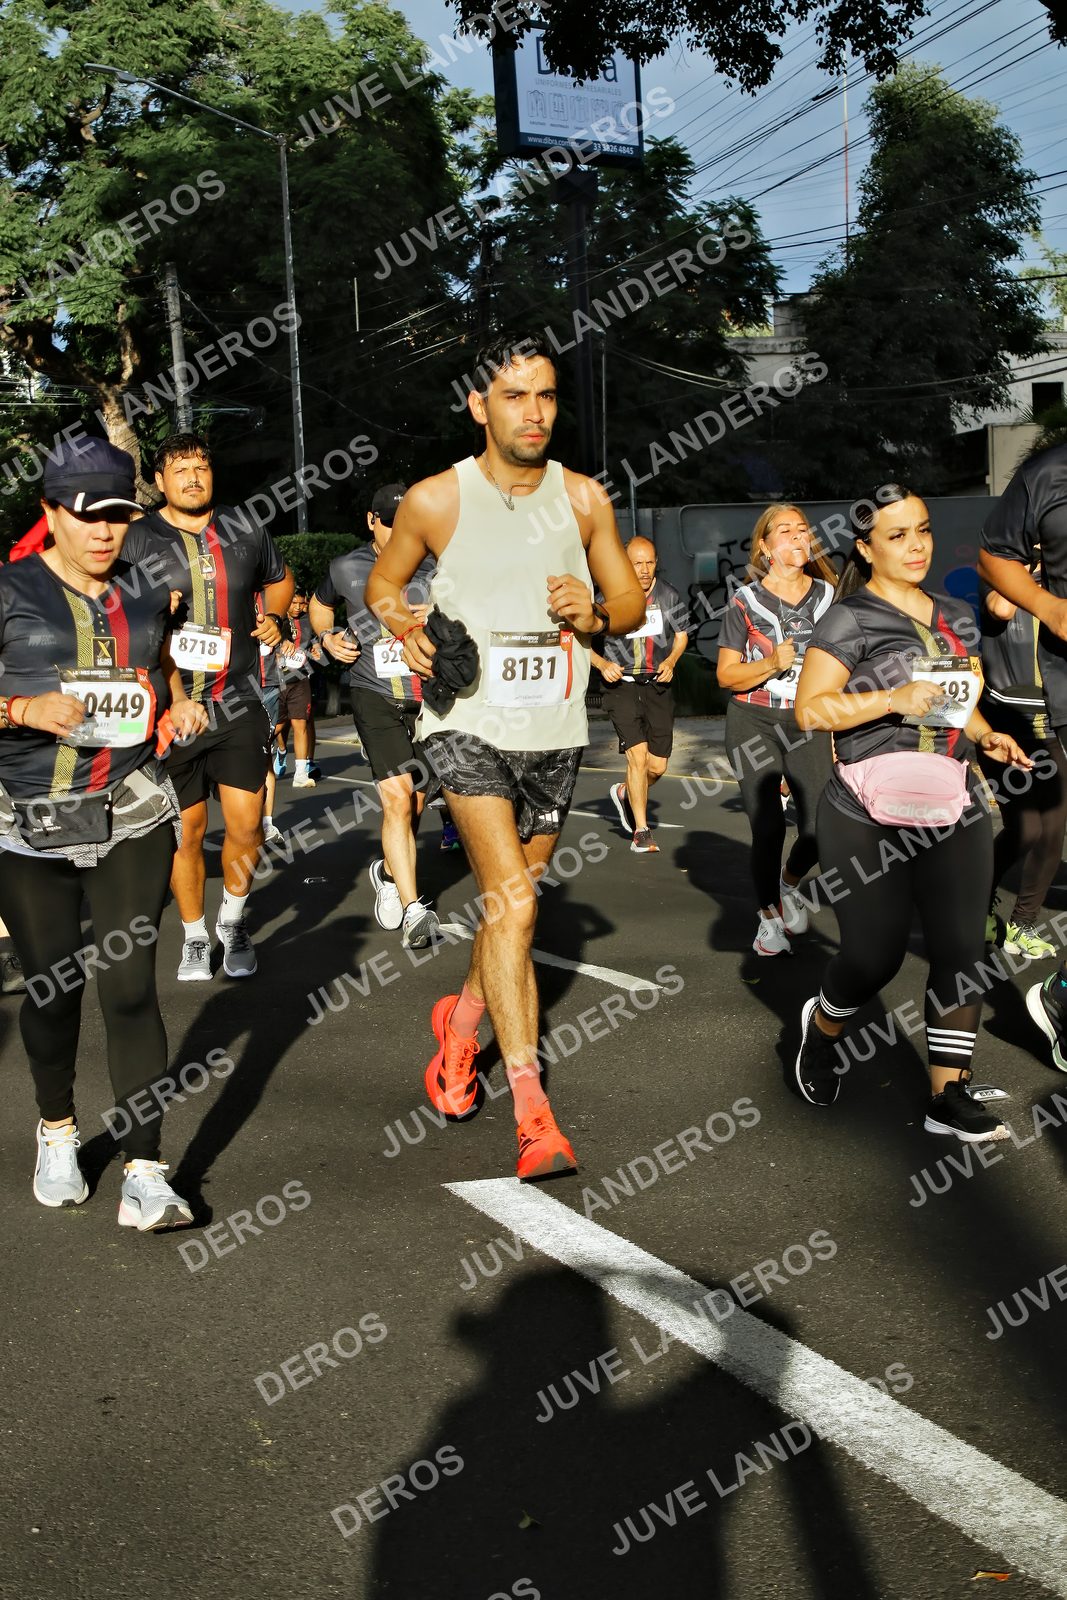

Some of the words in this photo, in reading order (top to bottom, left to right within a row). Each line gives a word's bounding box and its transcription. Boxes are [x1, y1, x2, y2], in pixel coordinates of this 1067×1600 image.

[178, 637, 217, 656] 8718
[502, 656, 557, 681] 8131
[786, 669, 800, 684] 9
[78, 691, 145, 719] 0449
[886, 802, 950, 818] adidas
